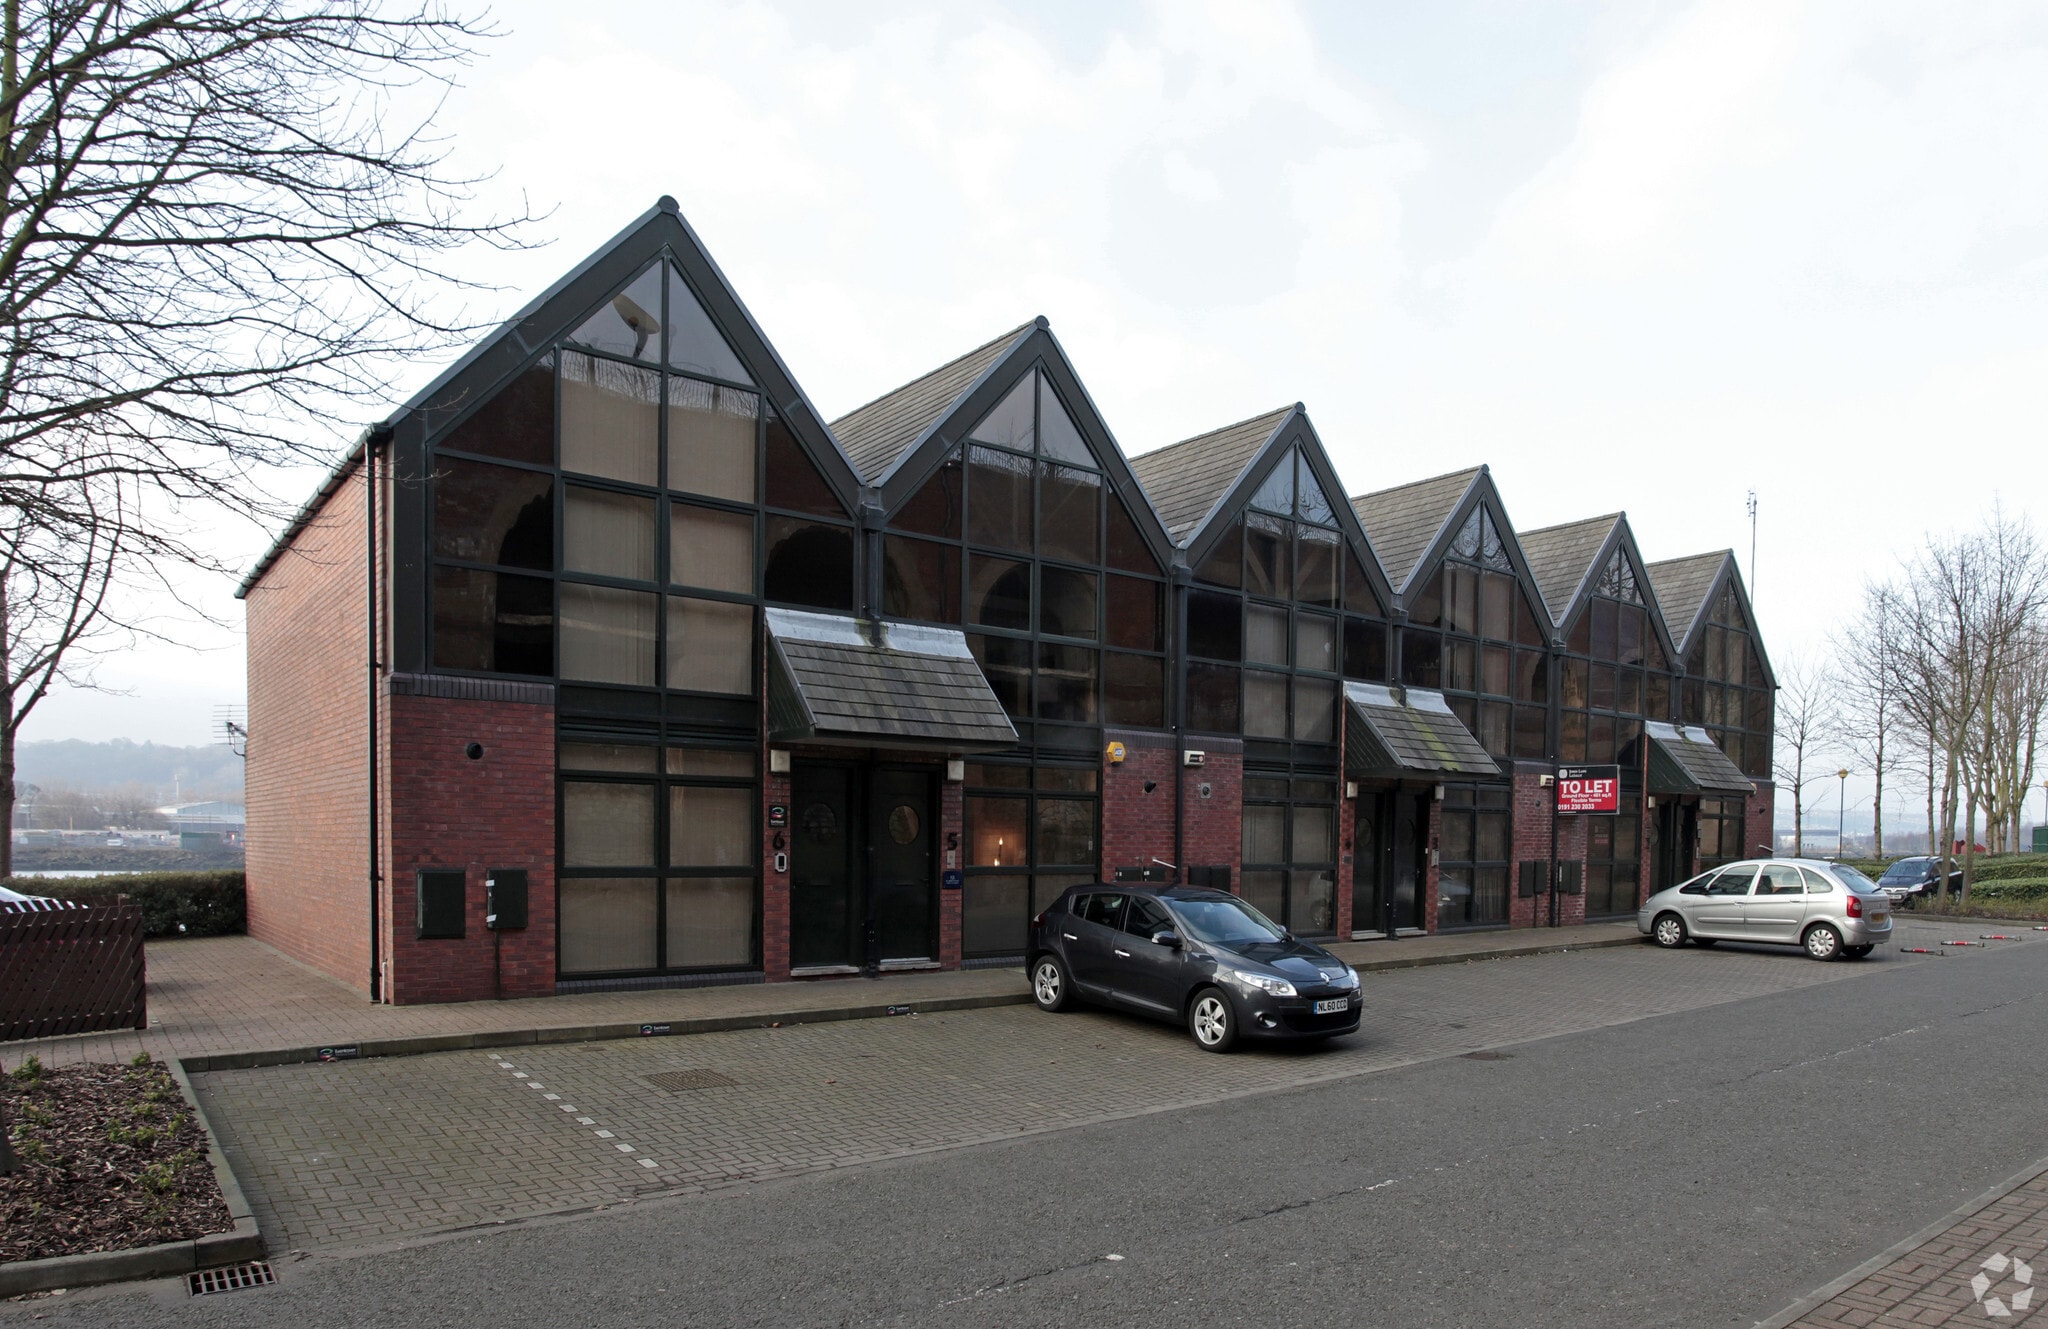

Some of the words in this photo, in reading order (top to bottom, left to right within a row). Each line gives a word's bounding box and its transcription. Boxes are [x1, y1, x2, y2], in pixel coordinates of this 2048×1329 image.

[1560, 781, 1581, 793] TO
[1585, 780, 1612, 793] LET
[773, 830, 785, 850] 6
[948, 832, 958, 850] 5
[1318, 1000, 1335, 1011] NL60
